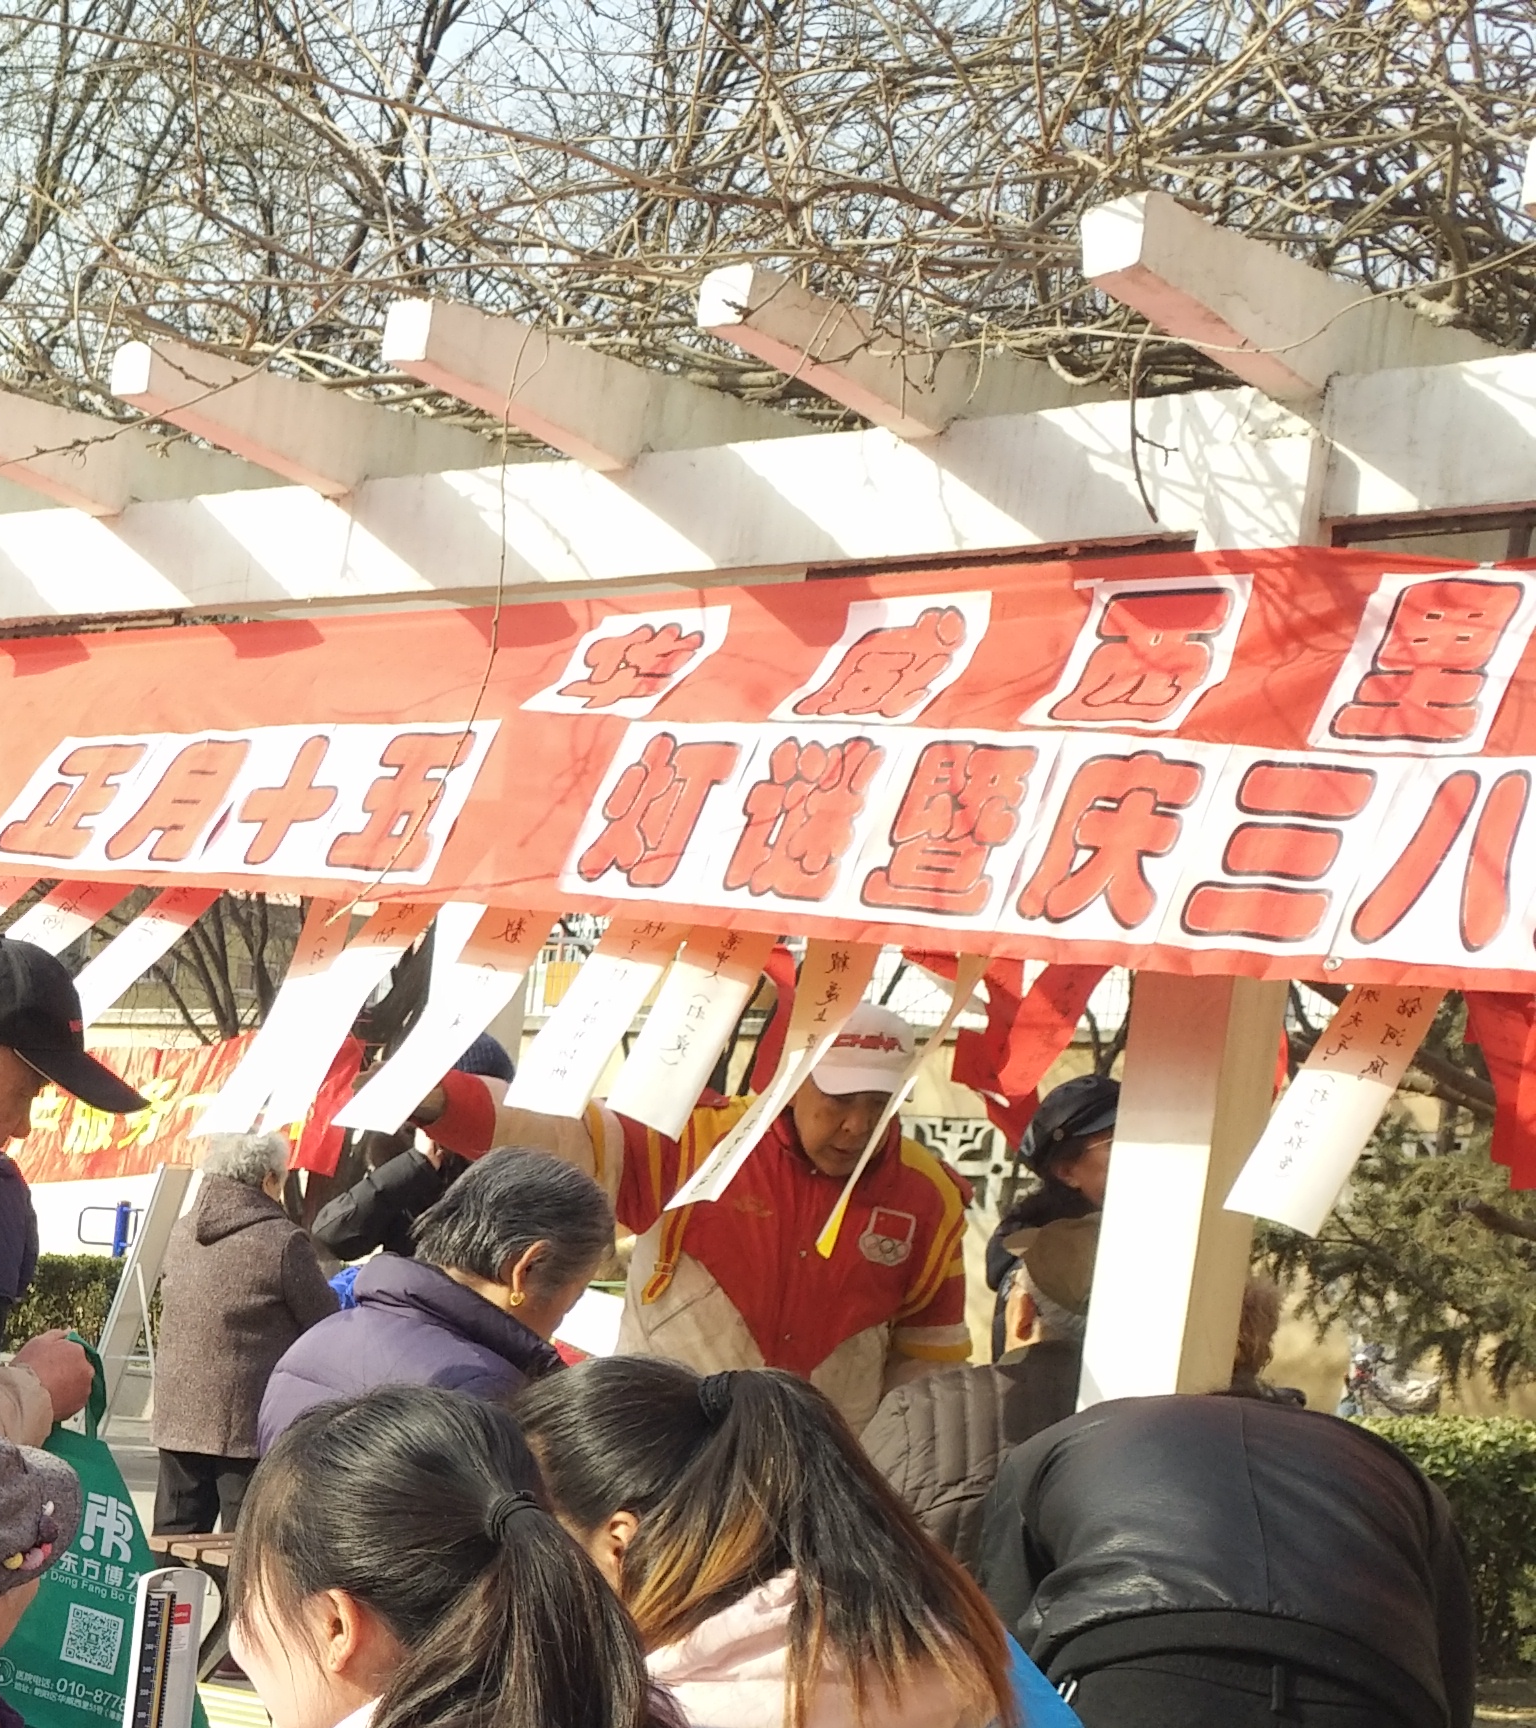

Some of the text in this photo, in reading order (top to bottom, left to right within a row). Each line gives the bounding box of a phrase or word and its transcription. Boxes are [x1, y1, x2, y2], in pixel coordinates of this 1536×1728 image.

[561, 580, 1523, 744] 华威西里
[577, 732, 1533, 952] 灯谜暨庆三八
[50, 1570, 78, 1589] Dong
[81, 1579, 108, 1598] Fang
[110, 1588, 126, 1602] Bo
[56, 1678, 126, 1712] 010-8778
